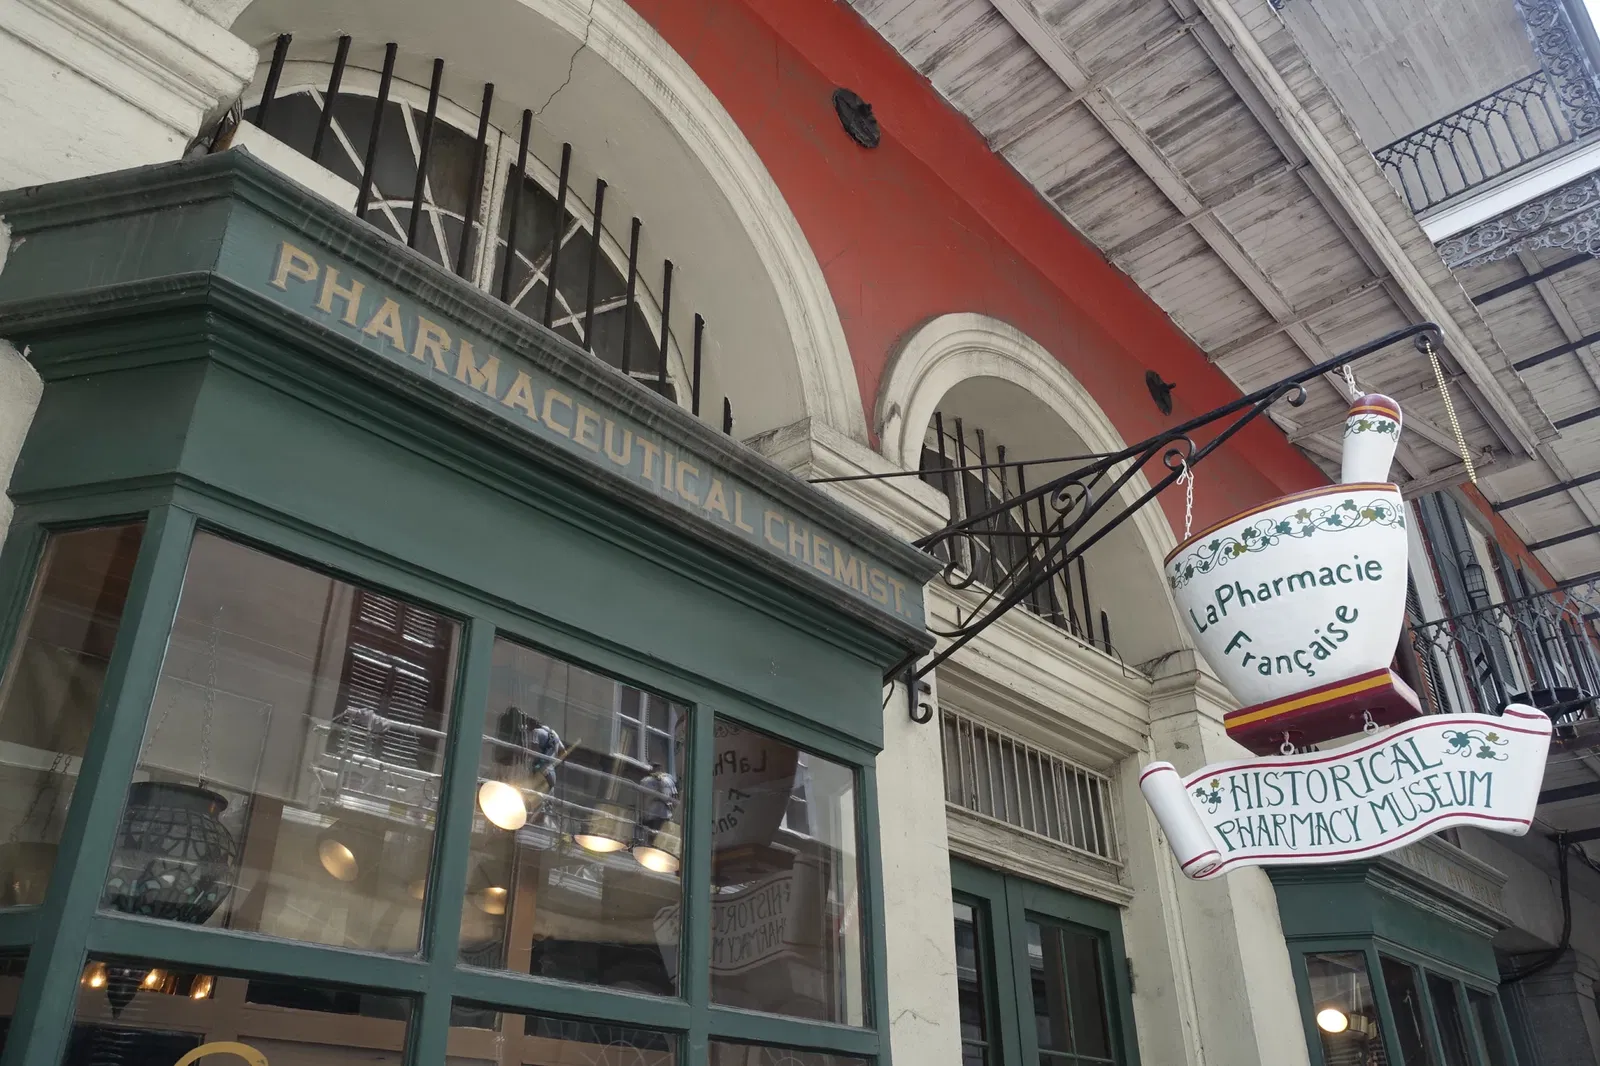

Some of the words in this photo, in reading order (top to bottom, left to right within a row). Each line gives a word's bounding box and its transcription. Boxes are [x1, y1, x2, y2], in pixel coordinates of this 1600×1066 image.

[267, 240, 753, 534] PHARMACEUTICAL
[762, 510, 912, 618] CHEMIST.
[1214, 554, 1383, 617] Pharmacie
[1223, 604, 1359, 677] Française
[1214, 804, 1363, 851] PHARMACY
[1370, 770, 1493, 835] MUSEUM
[1229, 736, 1444, 812] HISTORICAL
